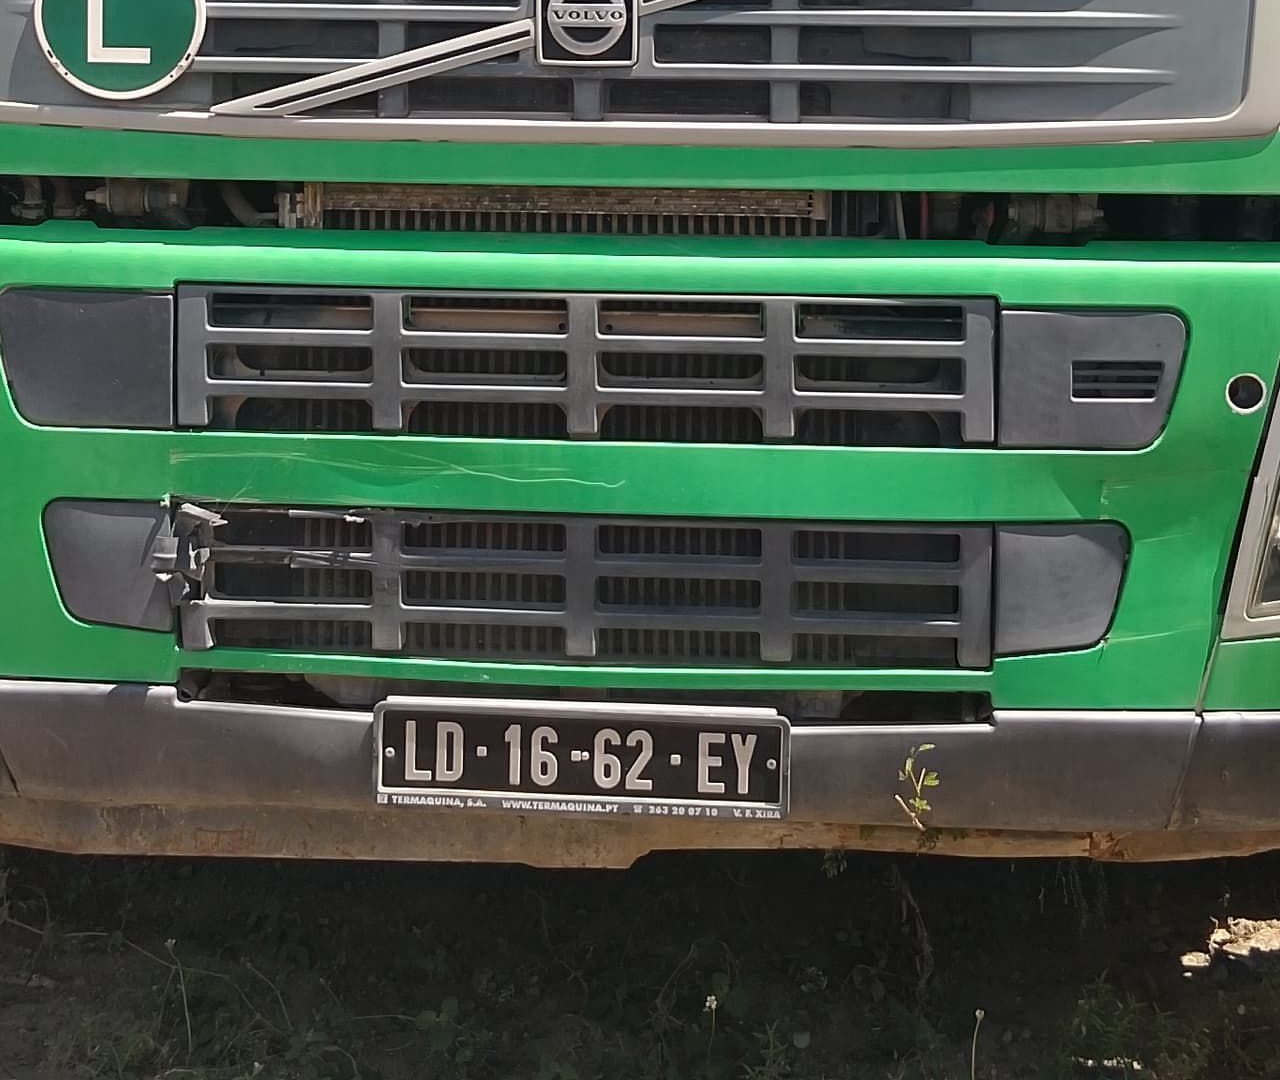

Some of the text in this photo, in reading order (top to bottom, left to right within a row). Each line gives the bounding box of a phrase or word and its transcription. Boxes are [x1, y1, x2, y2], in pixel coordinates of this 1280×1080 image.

[551, 10, 624, 22] VOLVO
[467, 799, 487, 808] S.A.
[502, 800, 619, 814] WWW.TERMAQUINA.PT
[648, 805, 669, 815] 263
[671, 806, 685, 816] 20
[688, 807, 701, 817] 07
[704, 807, 718, 817] 10
